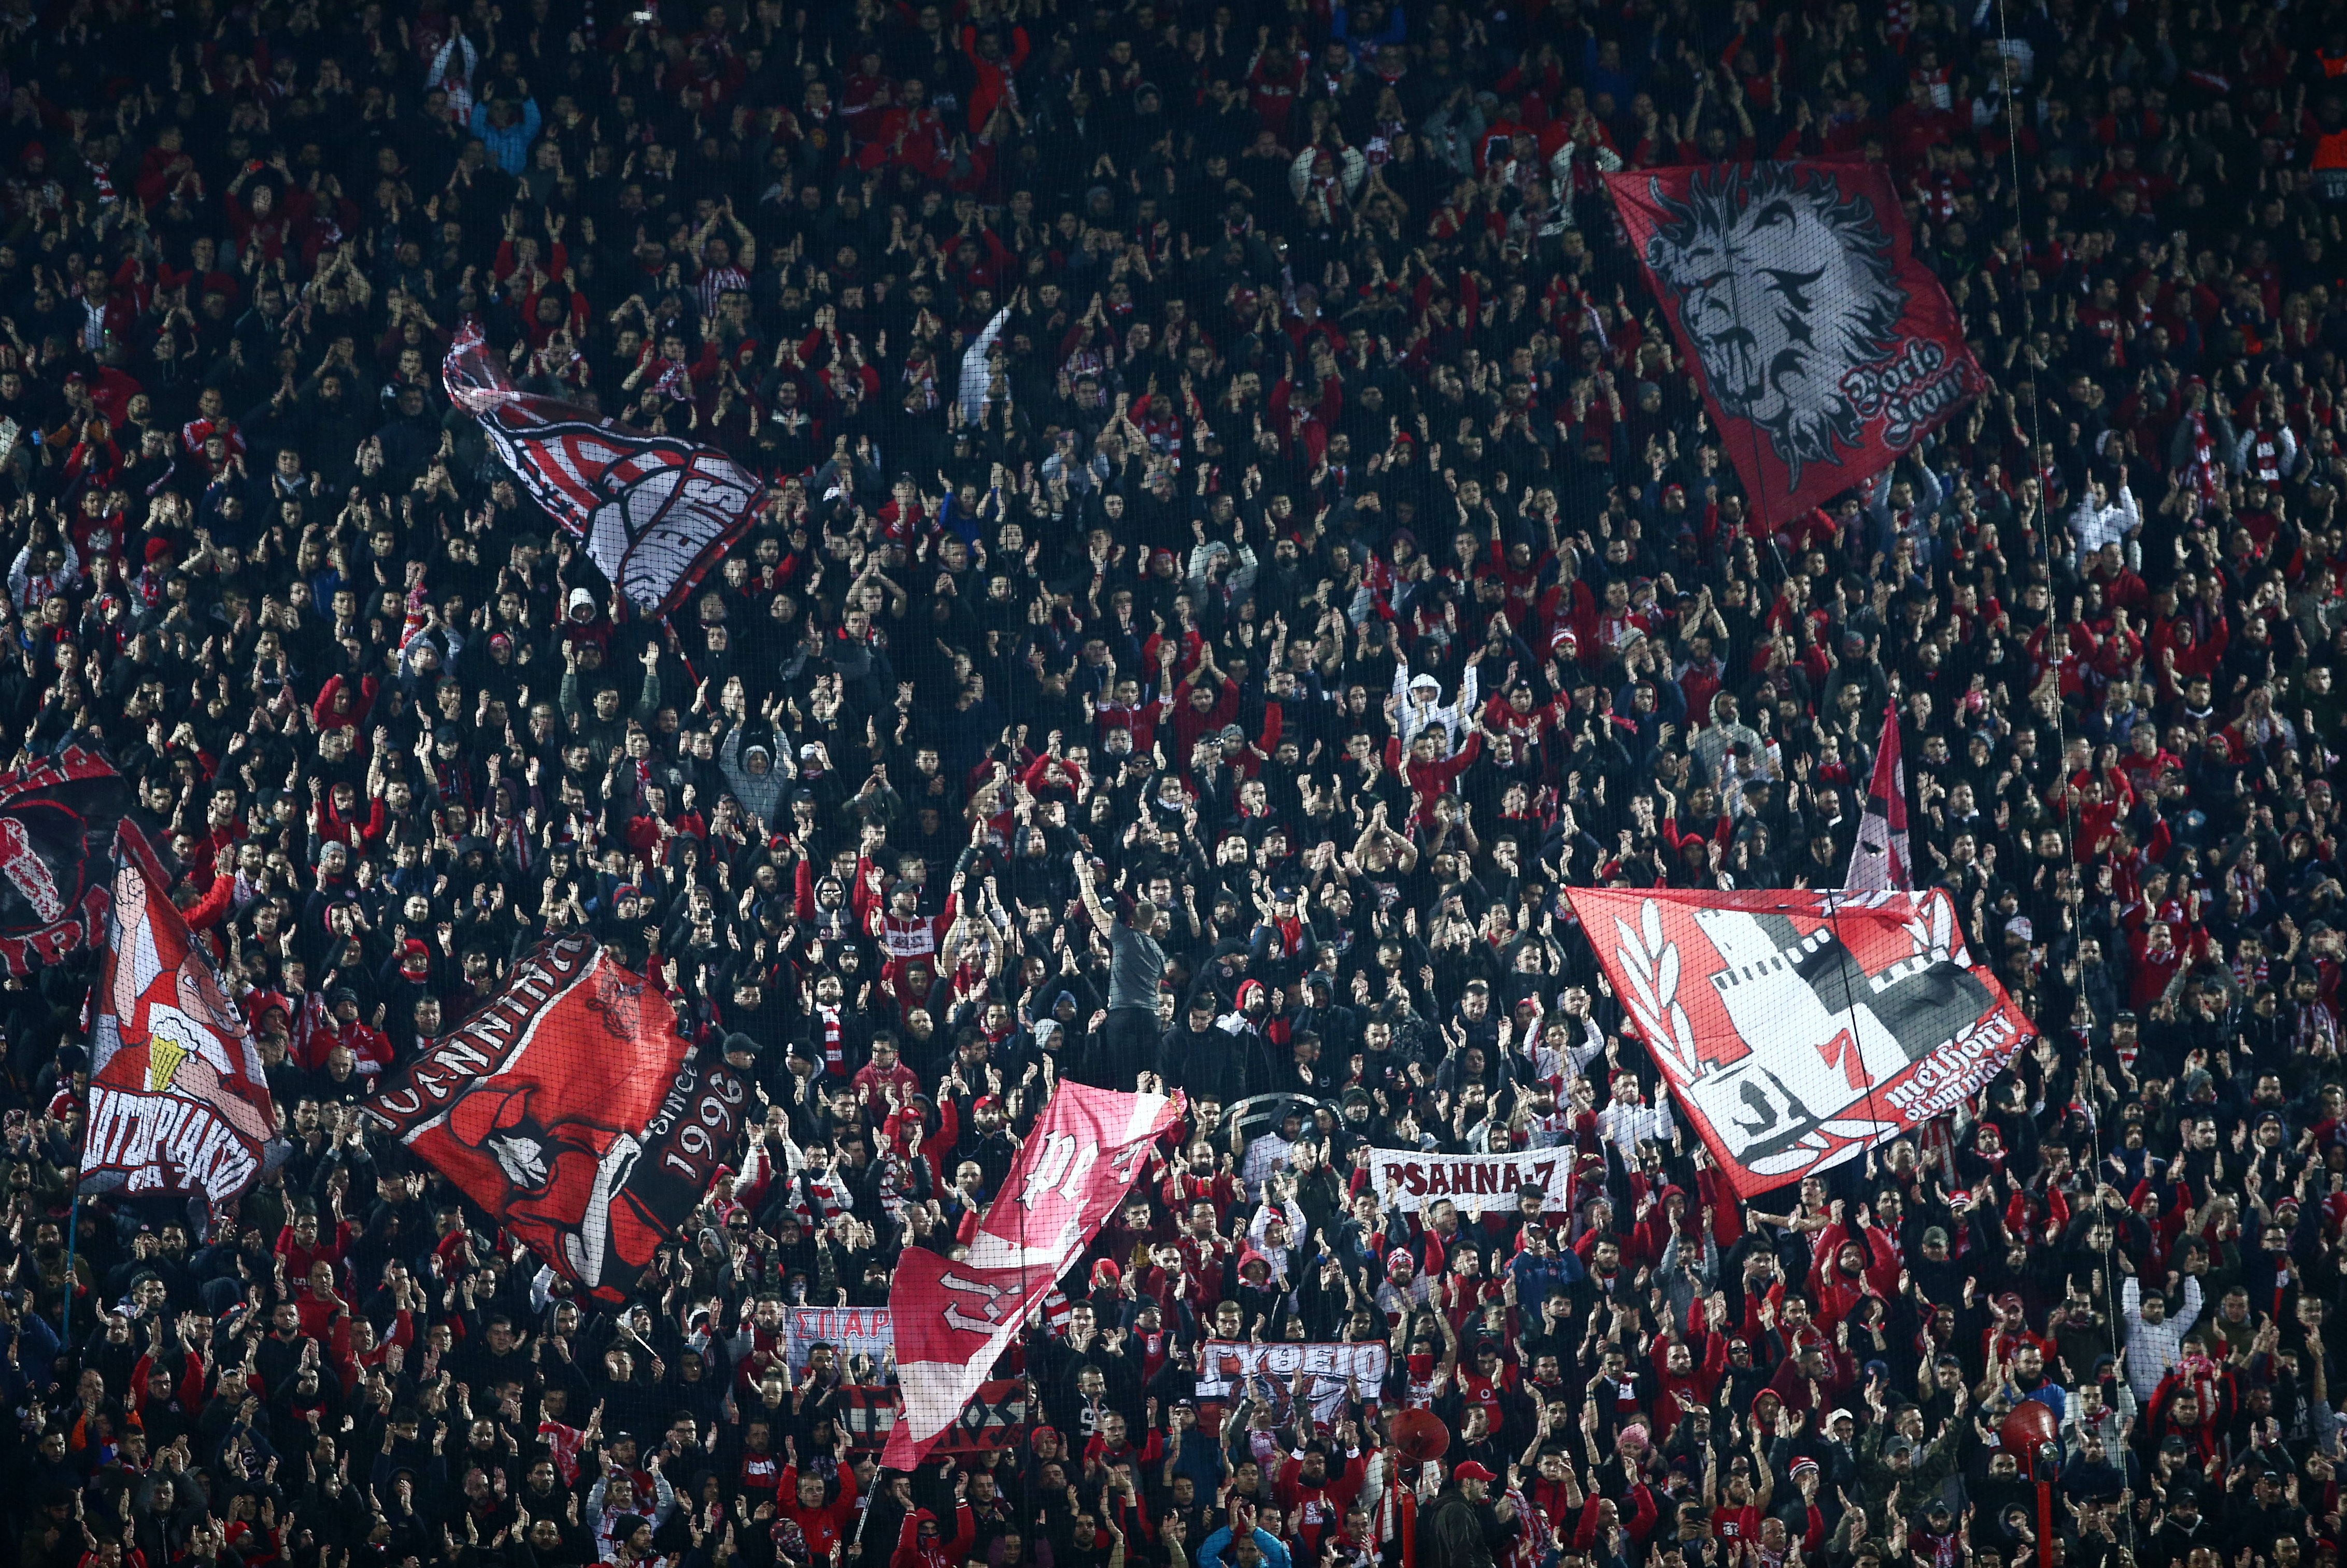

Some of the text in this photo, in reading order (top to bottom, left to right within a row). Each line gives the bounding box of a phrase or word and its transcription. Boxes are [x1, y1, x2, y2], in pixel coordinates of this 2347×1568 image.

[1815, 1028, 1874, 1091] 7
[665, 1073, 744, 1179] 1996
[794, 1309, 889, 1341] ΣΠΑΡ
